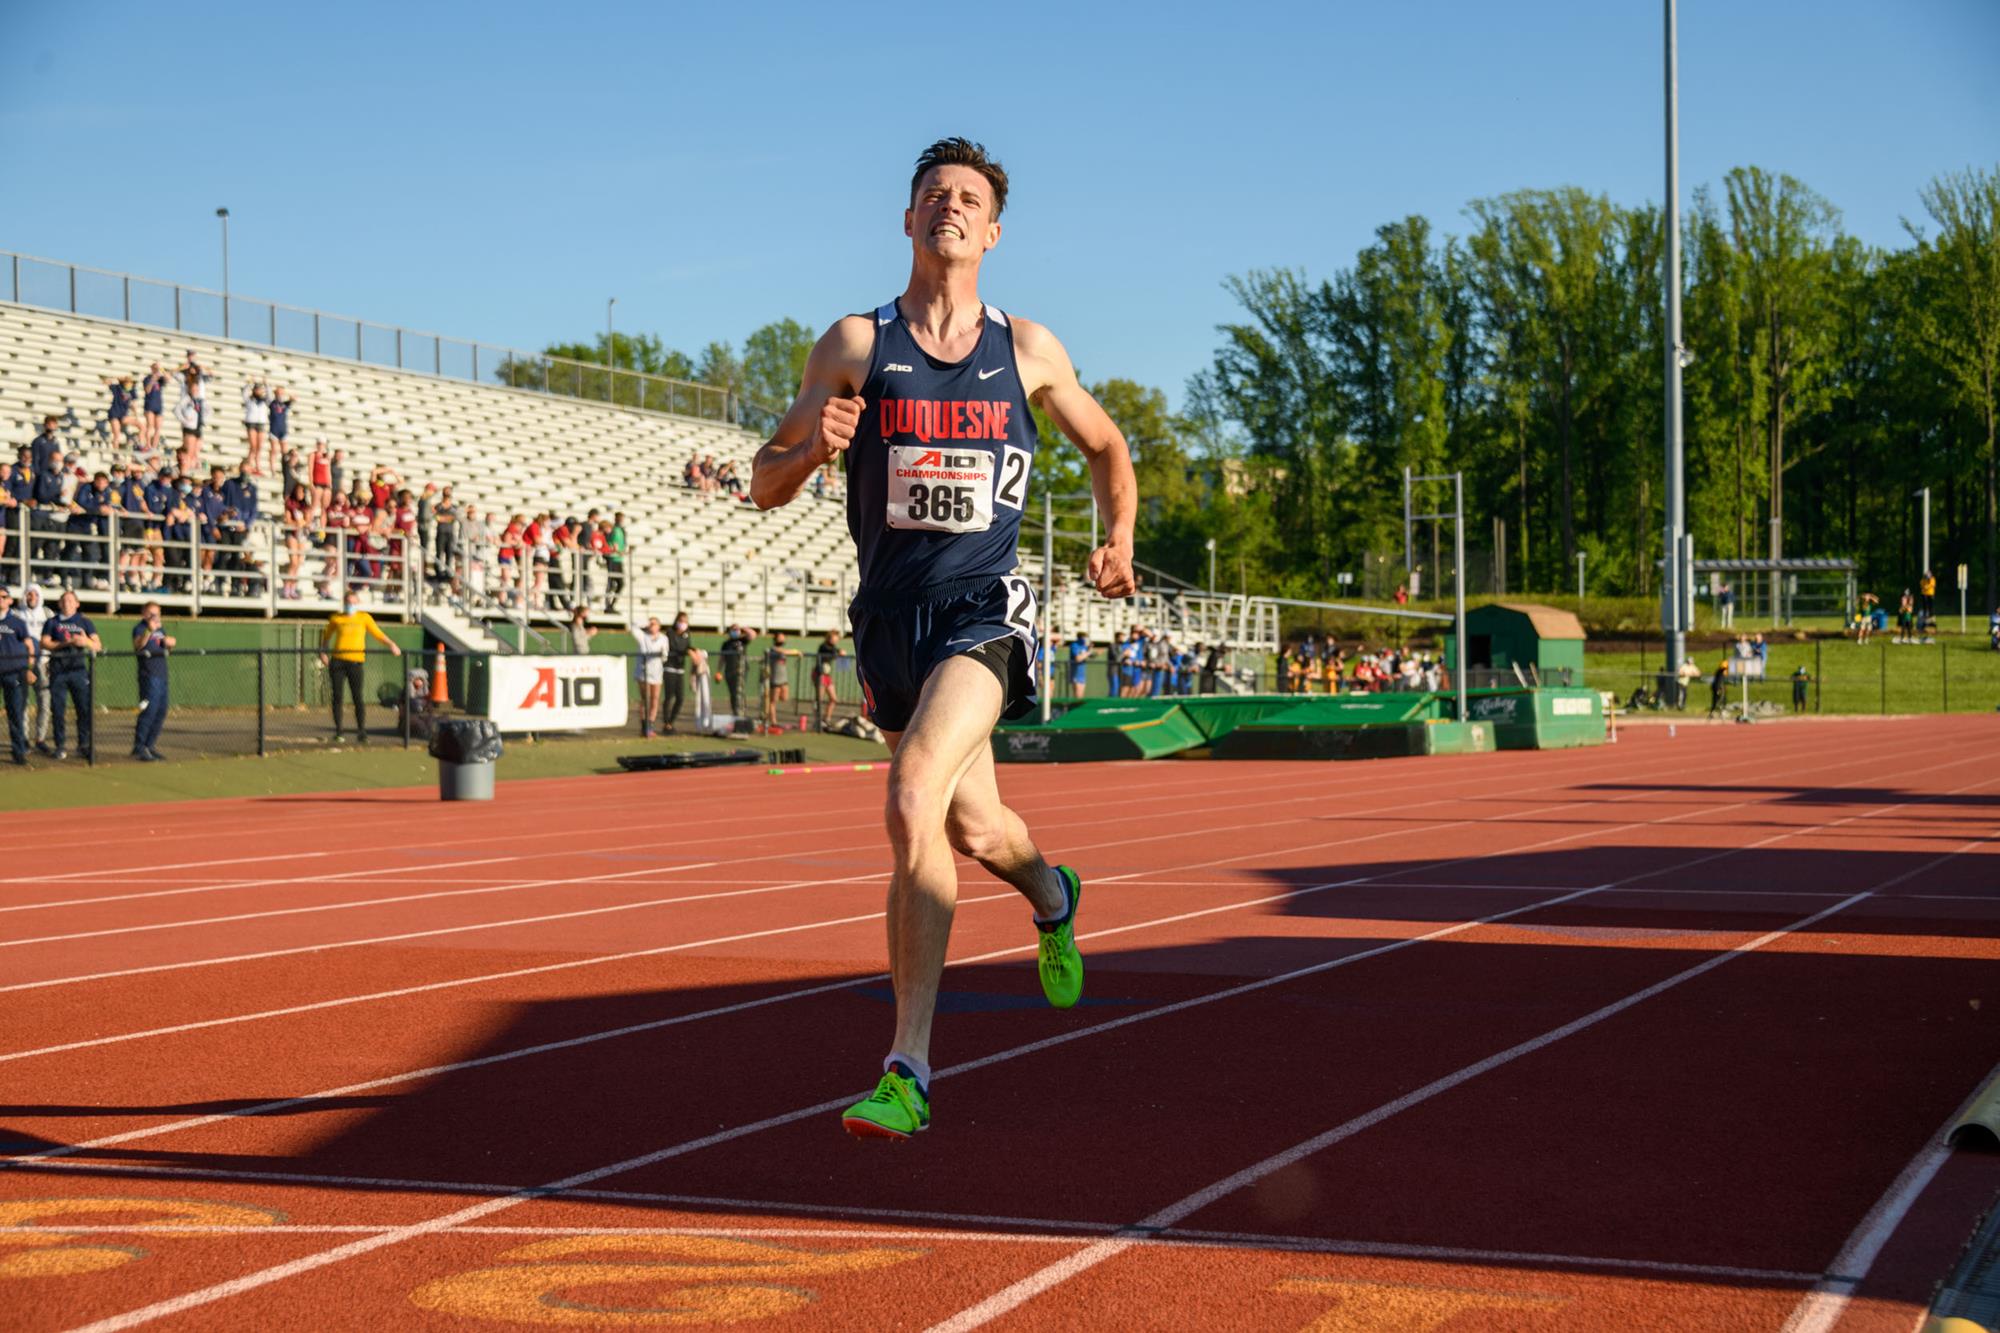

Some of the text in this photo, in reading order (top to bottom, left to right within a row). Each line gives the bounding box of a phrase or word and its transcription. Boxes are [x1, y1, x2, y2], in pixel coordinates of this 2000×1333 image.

[883, 363, 913, 373] A10
[880, 398, 1012, 443] DUQUESNE
[896, 468, 987, 481] CHAMPIONSHIPS
[911, 450, 976, 469] A10
[999, 452, 1025, 504] 2
[908, 484, 975, 523] 365
[1010, 578, 1030, 629] 2
[518, 667, 602, 709] A10
